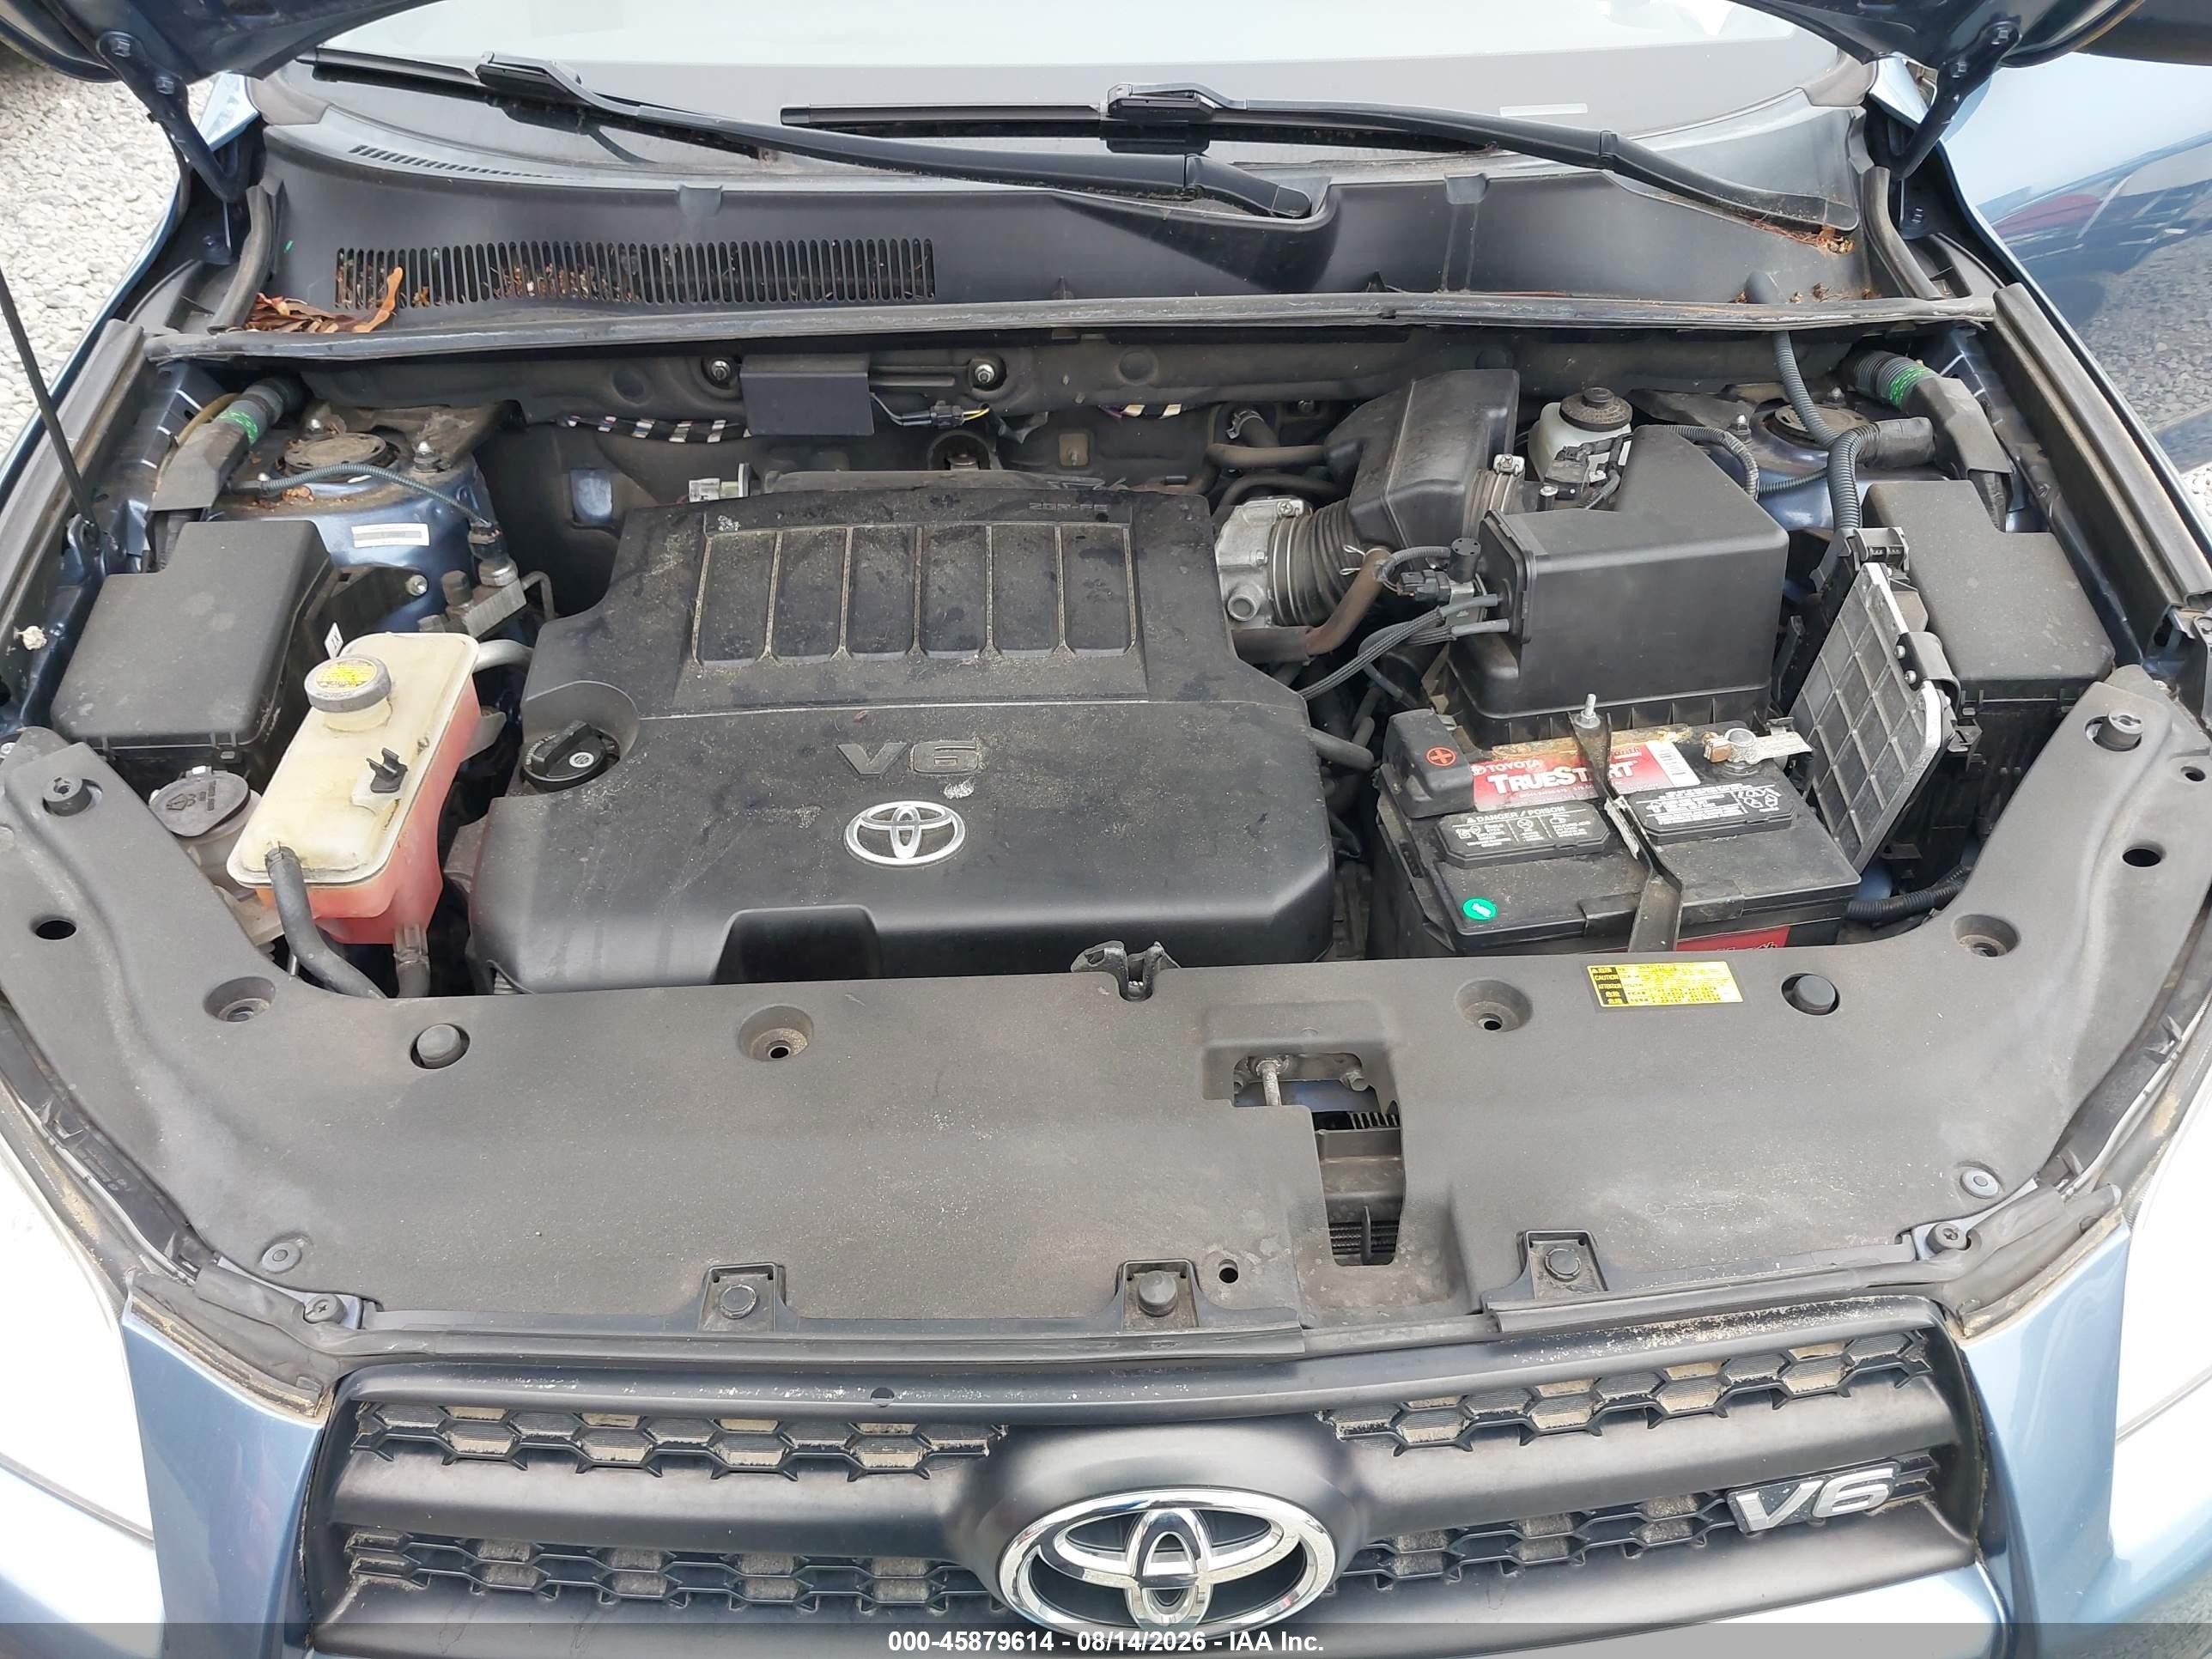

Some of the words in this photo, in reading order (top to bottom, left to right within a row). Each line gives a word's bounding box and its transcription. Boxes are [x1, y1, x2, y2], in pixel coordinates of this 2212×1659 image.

[836, 740, 980, 775] V6
[1486, 759, 1541, 774] TOYOTA
[1478, 811, 1519, 823] DANGER
[1528, 805, 1565, 816] POISON
[1735, 1467, 1895, 1532] V6
